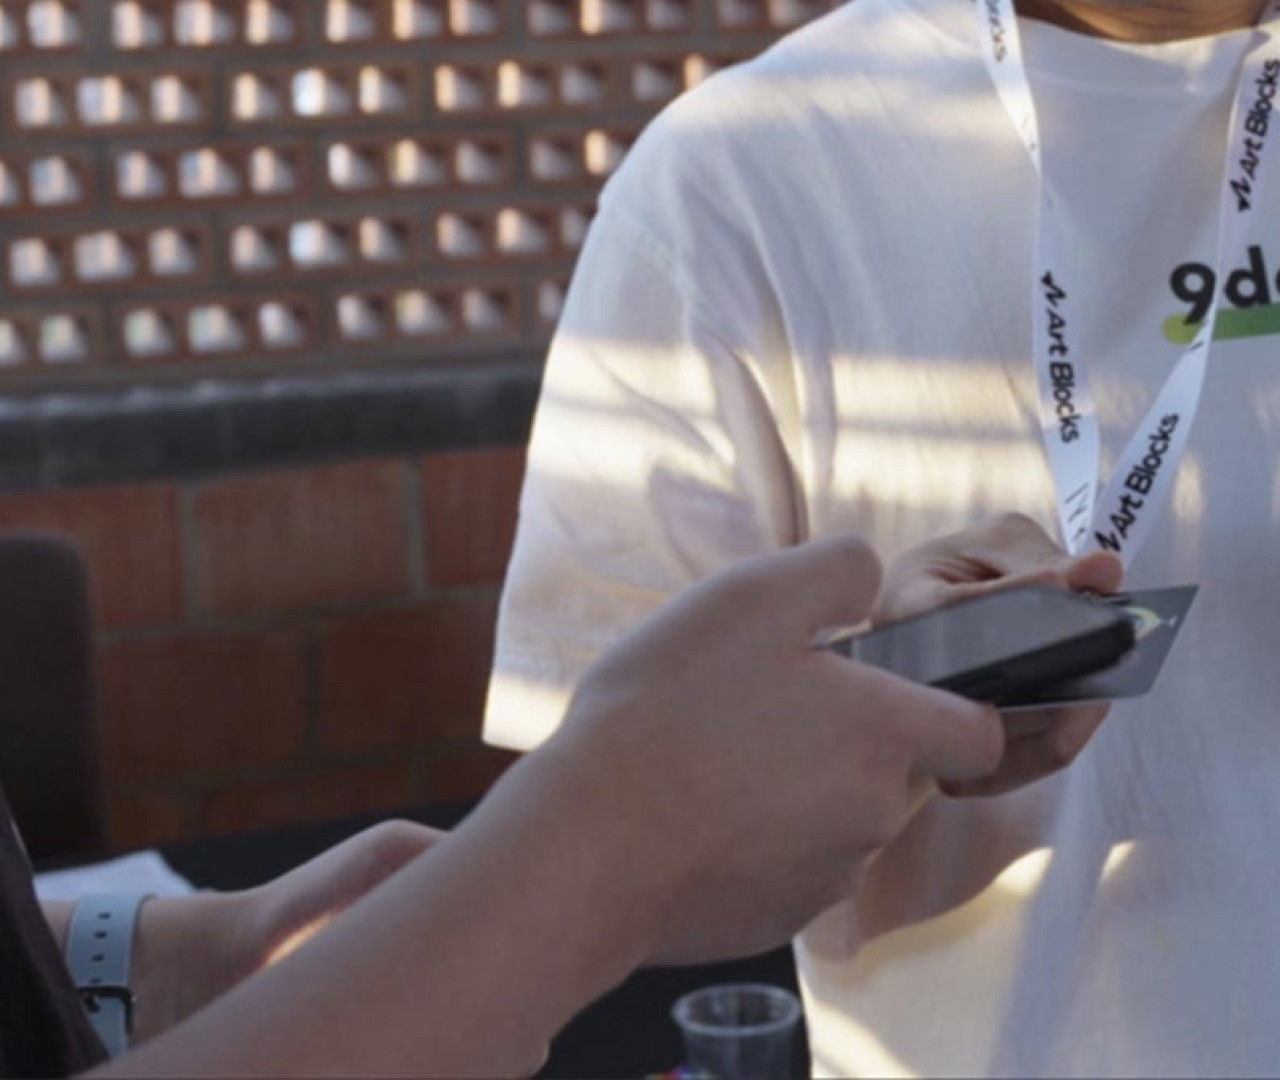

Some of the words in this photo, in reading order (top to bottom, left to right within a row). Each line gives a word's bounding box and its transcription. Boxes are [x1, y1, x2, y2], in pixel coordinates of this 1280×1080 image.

[1238, 137, 1264, 181] Art
[1046, 307, 1070, 356] Art
[1049, 361, 1082, 443] Blocks
[1124, 413, 1180, 496] Blocks
[1110, 493, 1144, 539] Art
